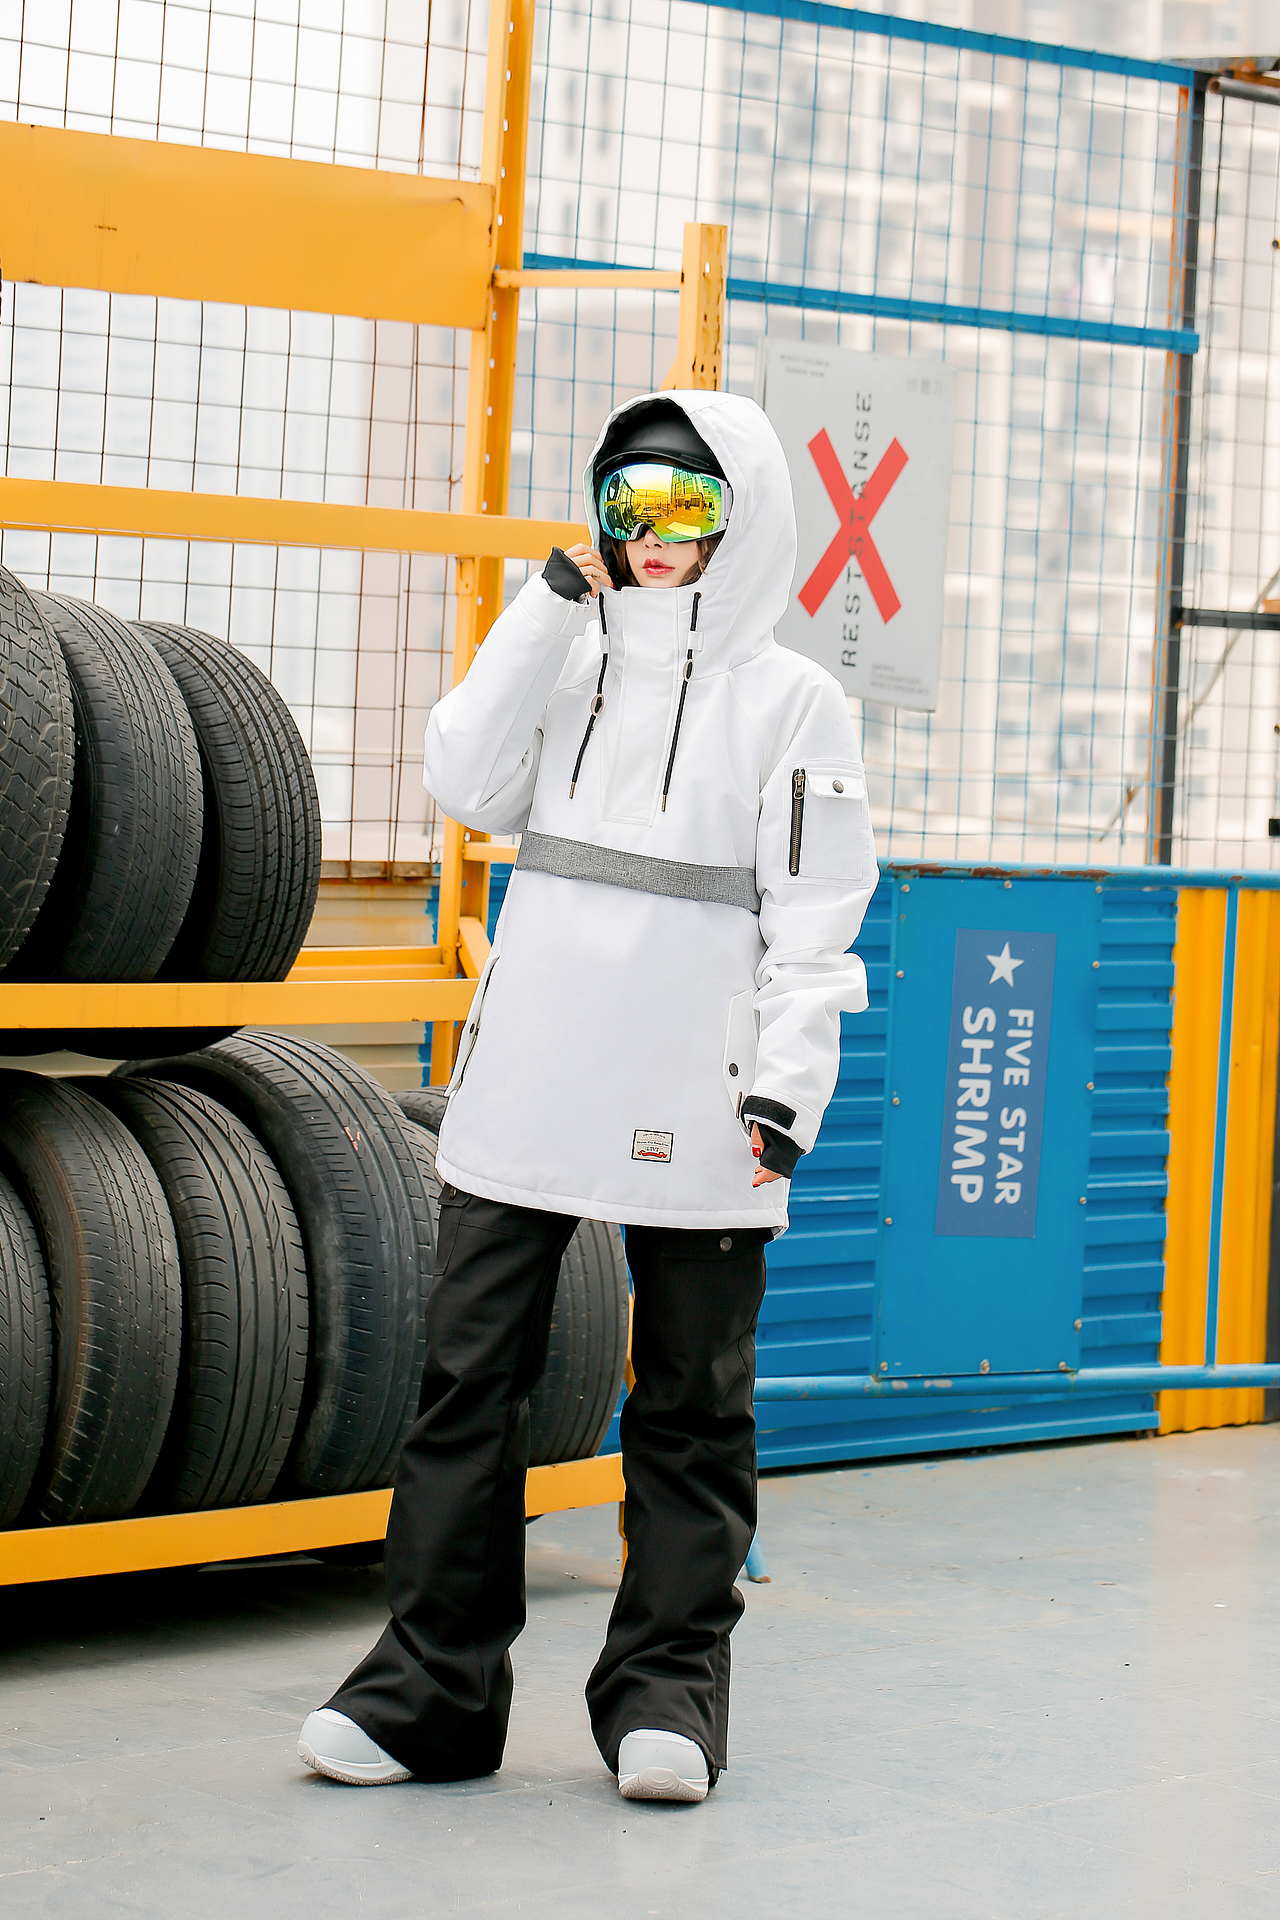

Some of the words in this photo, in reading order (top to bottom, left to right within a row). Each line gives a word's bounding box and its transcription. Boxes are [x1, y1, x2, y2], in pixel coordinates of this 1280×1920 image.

[1003, 1008, 1035, 1086] FIVE
[950, 1005, 997, 1204] SHRIMP
[993, 1107, 1027, 1204] STAR
